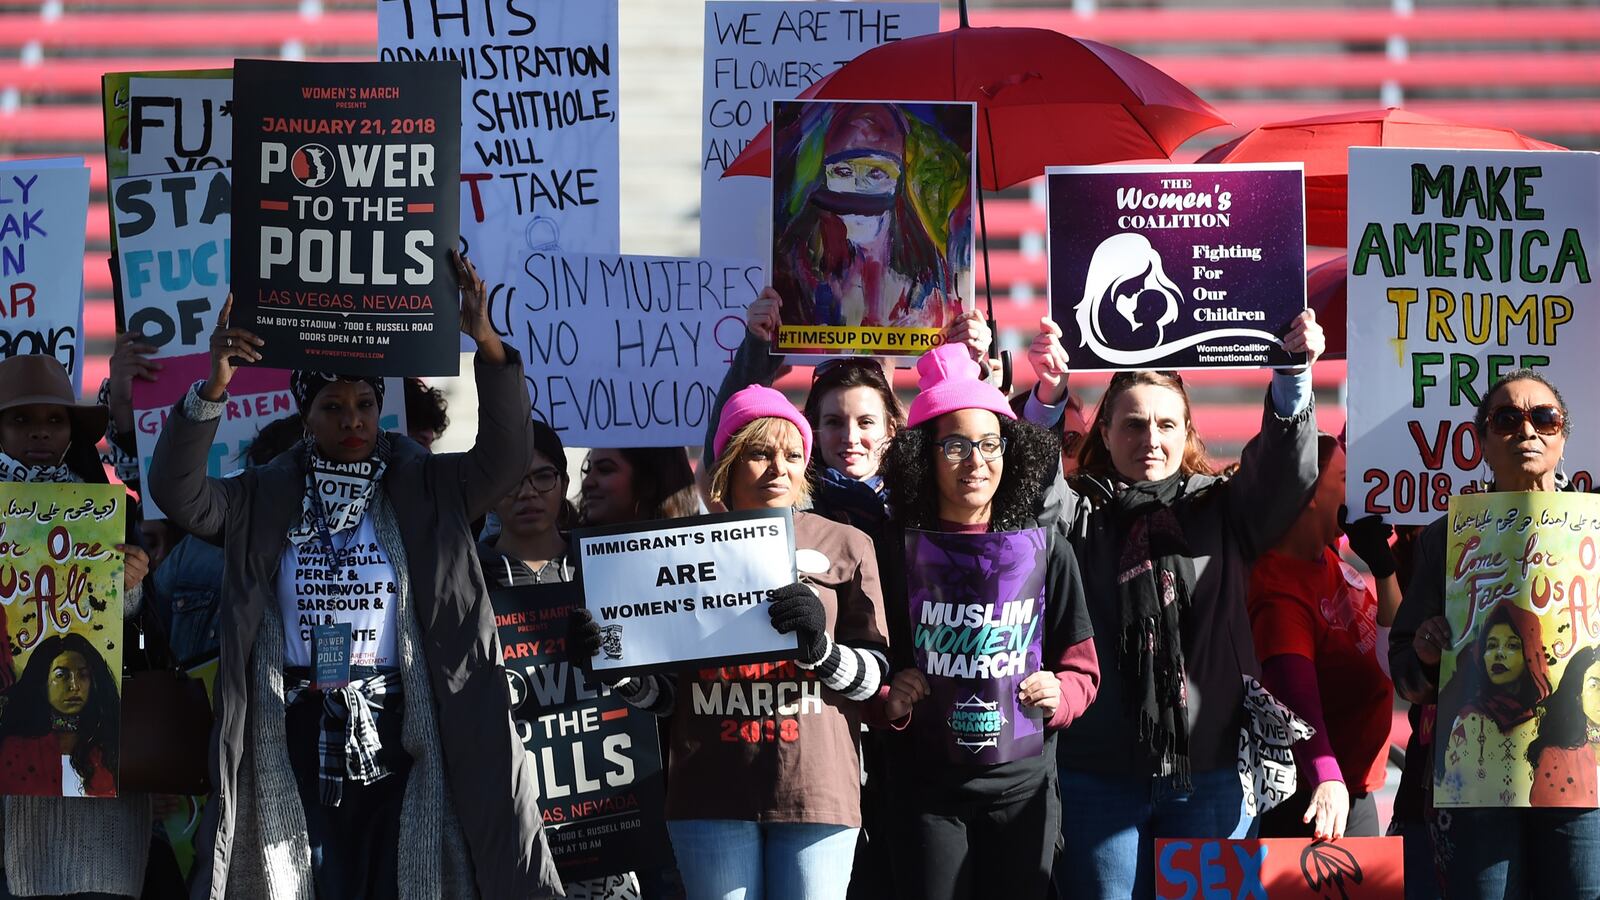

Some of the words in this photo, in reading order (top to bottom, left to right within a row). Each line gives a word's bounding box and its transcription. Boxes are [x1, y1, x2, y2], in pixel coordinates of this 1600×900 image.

[379, 0, 536, 39] THIS
[714, 12, 762, 45] WE
[772, 10, 831, 45] ARE
[840, 9, 902, 44] THE
[715, 58, 824, 90] FLOWERS
[302, 87, 357, 99] WOMEN'S
[360, 87, 400, 99] MARCH
[472, 89, 615, 133] SHITHOLE,
[709, 99, 751, 128] GO
[262, 117, 356, 134] JANUARY
[360, 119, 386, 135] 21,
[391, 118, 436, 134] 2018
[260, 142, 435, 188] POWER
[474, 138, 544, 167] WILL
[499, 169, 600, 215] TAKE
[1115, 184, 1232, 211] Women's
[1160, 179, 1192, 189] THE
[1411, 163, 1545, 221] MAKE
[293, 195, 334, 221] TO
[342, 197, 404, 221] THE
[1117, 213, 1231, 229] COALITION
[260, 226, 434, 285] POLLS
[1192, 245, 1262, 262] Fighting
[1352, 223, 1592, 284] AMERICA
[524, 253, 588, 312] SIN
[599, 256, 764, 313] MUJERES
[1192, 266, 1224, 280] For
[258, 289, 291, 305] LAS
[295, 293, 357, 310] VEGAS,
[363, 295, 433, 310] NEVADA
[1193, 287, 1227, 301] Our
[129, 298, 209, 347] OF
[256, 316, 274, 325] SAM
[276, 318, 298, 327] BOYD
[300, 319, 336, 330] STADIUM
[344, 322, 364, 331] 7000
[366, 323, 373, 331] E.
[376, 323, 410, 332] RUSSELL
[412, 323, 434, 332] ROAD
[1193, 308, 1266, 321] Children
[1387, 288, 1574, 346] TRUMP
[300, 332, 326, 342] DOORS
[328, 334, 349, 343] OPEN
[352, 336, 362, 344] AT
[366, 336, 375, 345] 10
[377, 336, 390, 345] AM
[527, 320, 579, 366] NO
[616, 319, 701, 368] HAY
[779, 331, 857, 345] #TIMESUP
[861, 332, 882, 345] DV
[887, 332, 906, 346] BY
[1196, 343, 1271, 353] WomensCoalition
[1198, 353, 1268, 363] International.org
[1363, 469, 1450, 514] 2018
[48, 525, 114, 563] One
[369, 543, 379, 553] &
[586, 532, 705, 556] IMMIGRANT'S
[711, 524, 779, 543] RIGHTS
[1455, 536, 1509, 583] Come
[1513, 532, 1563, 580] for
[347, 569, 359, 580] &
[386, 582, 397, 593] &
[655, 561, 717, 587] ARE
[18, 564, 91, 649] All
[297, 598, 369, 611] SARSOUR
[373, 597, 384, 609] &
[600, 597, 696, 620] WOMEN'S
[702, 589, 776, 610] RIGHTS
[920, 598, 1035, 629] MUSLIM
[1454, 567, 1520, 648] Face
[1530, 574, 1564, 615] Us
[298, 614, 320, 626] ALI
[914, 614, 1038, 660] WOMEN
[317, 651, 344, 663] POLLS
[927, 649, 1027, 679] MARCH
[691, 681, 822, 716] MARCH
[538, 707, 600, 740] THE
[952, 710, 1001, 722] MPOWER
[952, 720, 1001, 733] CHANGE
[1156, 841, 1268, 900] SEX
